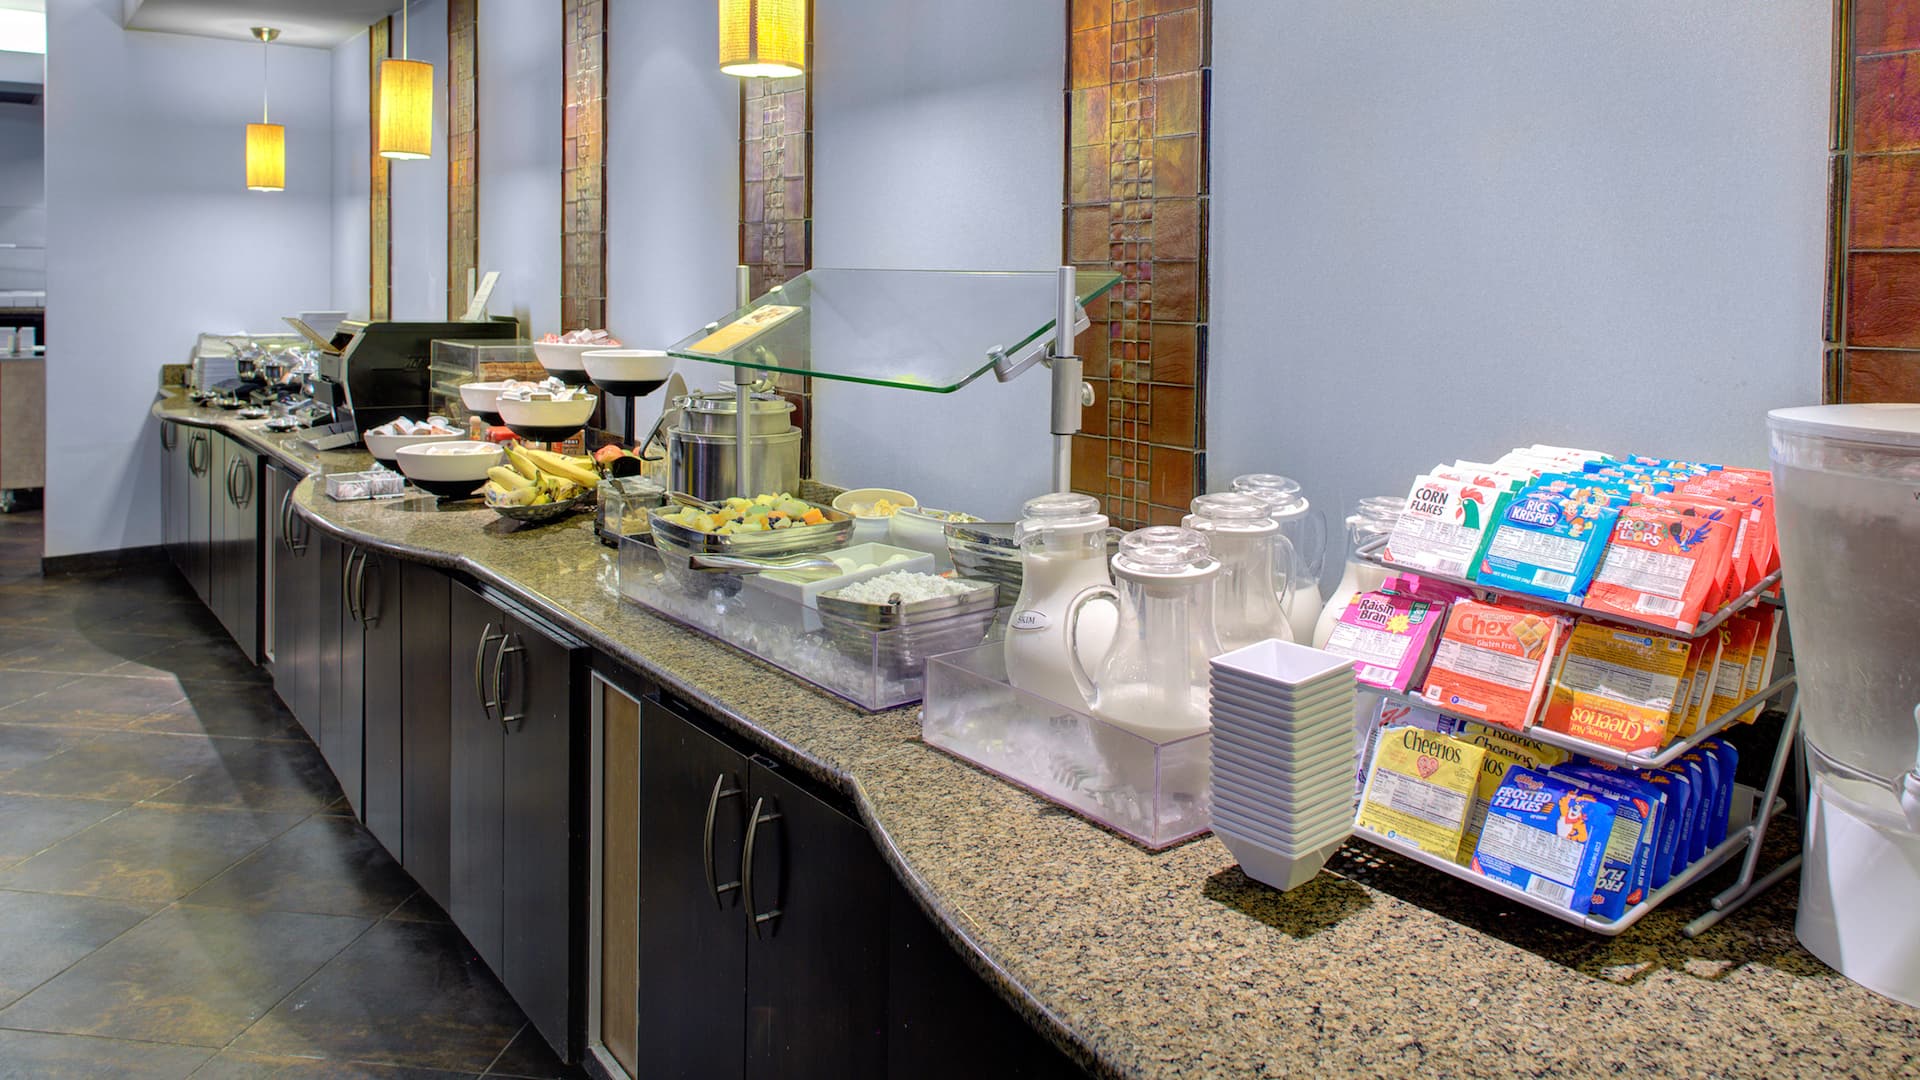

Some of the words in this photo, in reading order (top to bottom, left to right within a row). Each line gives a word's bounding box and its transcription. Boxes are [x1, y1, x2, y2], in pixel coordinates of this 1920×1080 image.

[1416, 488, 1449, 505] CORN
[1410, 500, 1444, 516] FLAKES
[1526, 500, 1549, 513] RICE
[1511, 505, 1557, 525] KRISPIES
[1615, 519, 1661, 534] FROOT
[1620, 530, 1662, 546] LOOPS
[1360, 599, 1394, 616] Raisin
[1017, 615, 1036, 625] SKIM
[1360, 610, 1387, 624] Bran
[1457, 613, 1512, 637] Chex
[1476, 639, 1501, 649] Gluten
[1570, 707, 1642, 741] Cheerios
[1403, 729, 1462, 763] Cheerios
[1495, 786, 1553, 803] FROSTED
[1494, 796, 1543, 812] FLAKES
